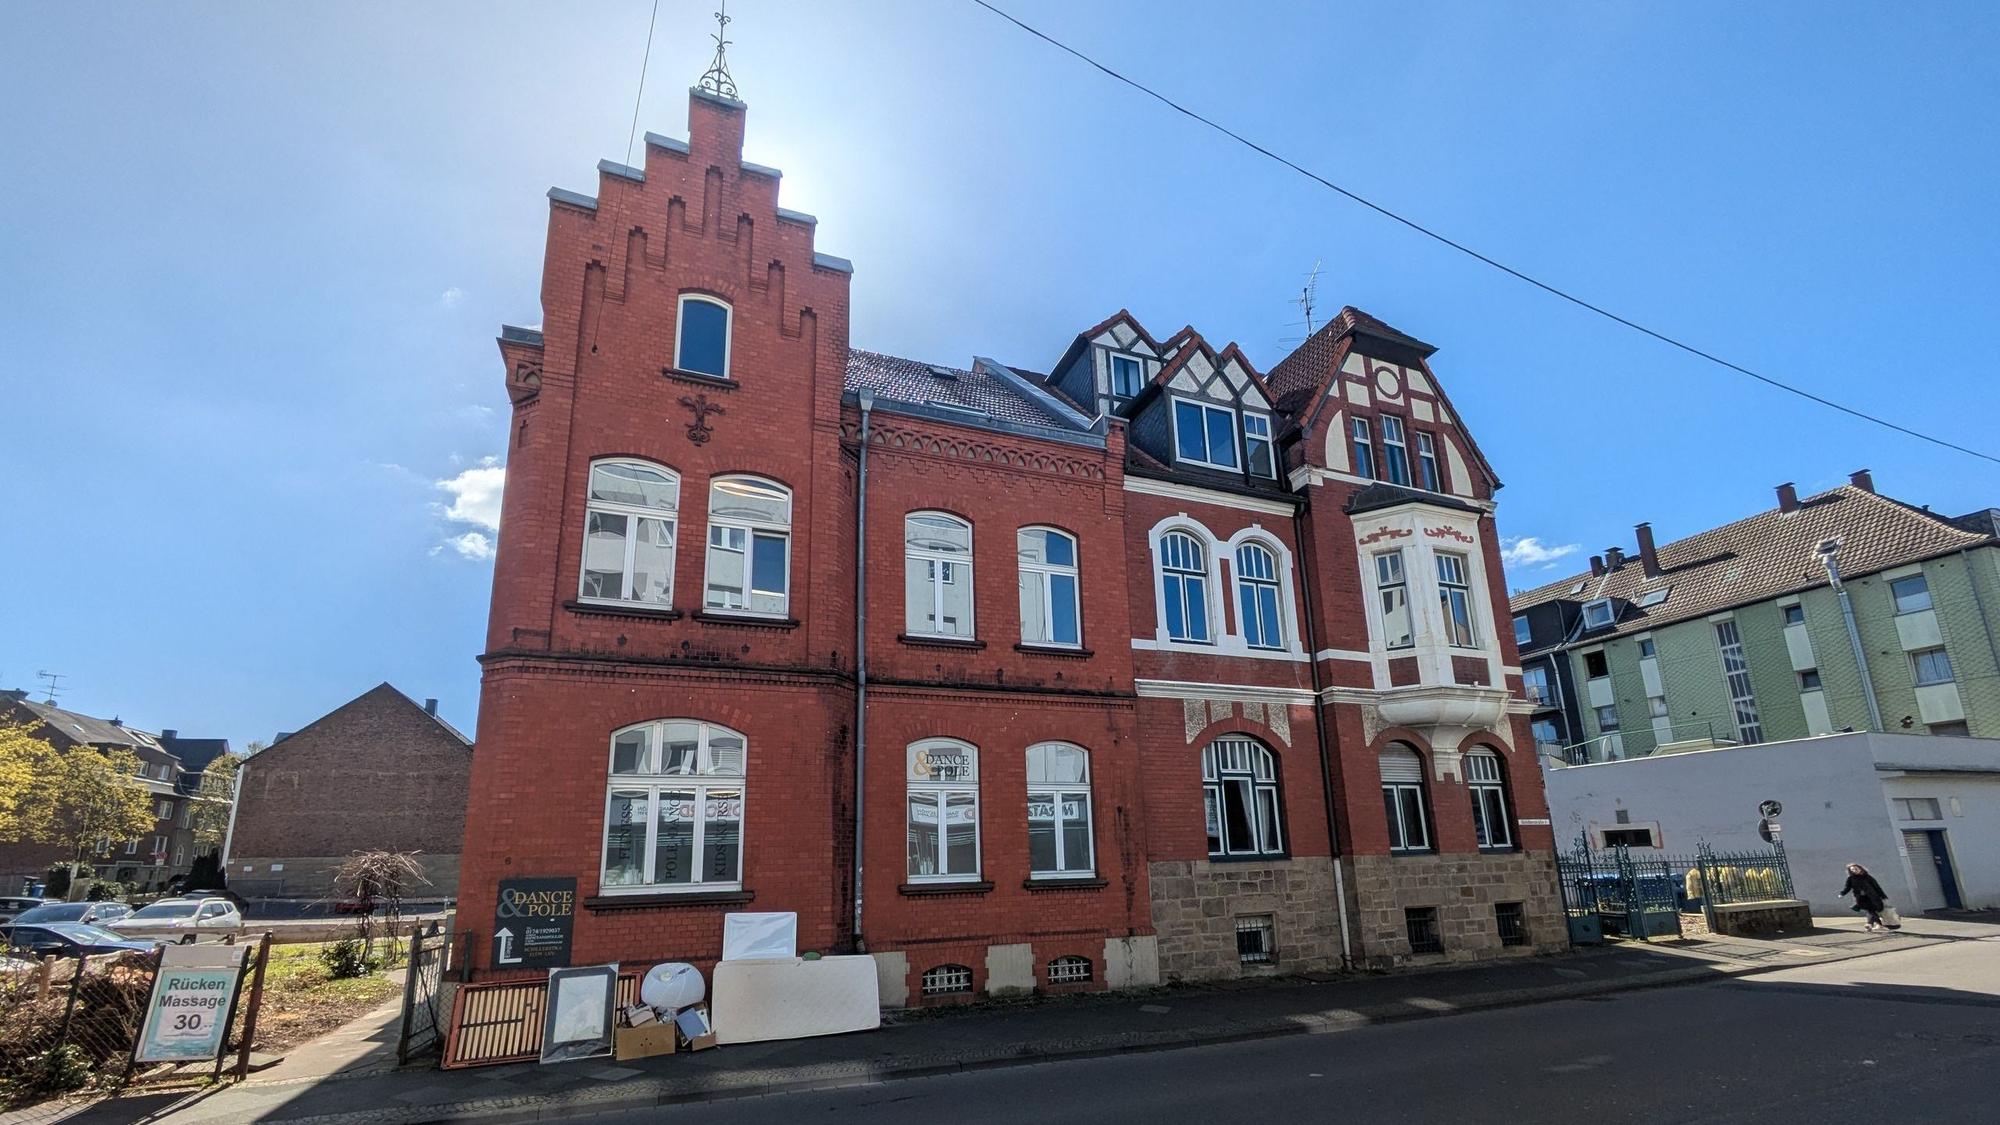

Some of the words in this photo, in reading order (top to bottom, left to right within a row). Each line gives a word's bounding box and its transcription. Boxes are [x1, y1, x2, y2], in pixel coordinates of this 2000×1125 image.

[925, 753, 970, 766] DANCE
[937, 765, 970, 777] POLE
[619, 804, 633, 860] FITNESS
[665, 843, 679, 878] POLE
[714, 843, 729, 877] KIDS
[514, 890, 573, 904] DANCE
[527, 903, 572, 917] POLE
[168, 978, 226, 991] Rücken
[159, 995, 226, 1009] Massage
